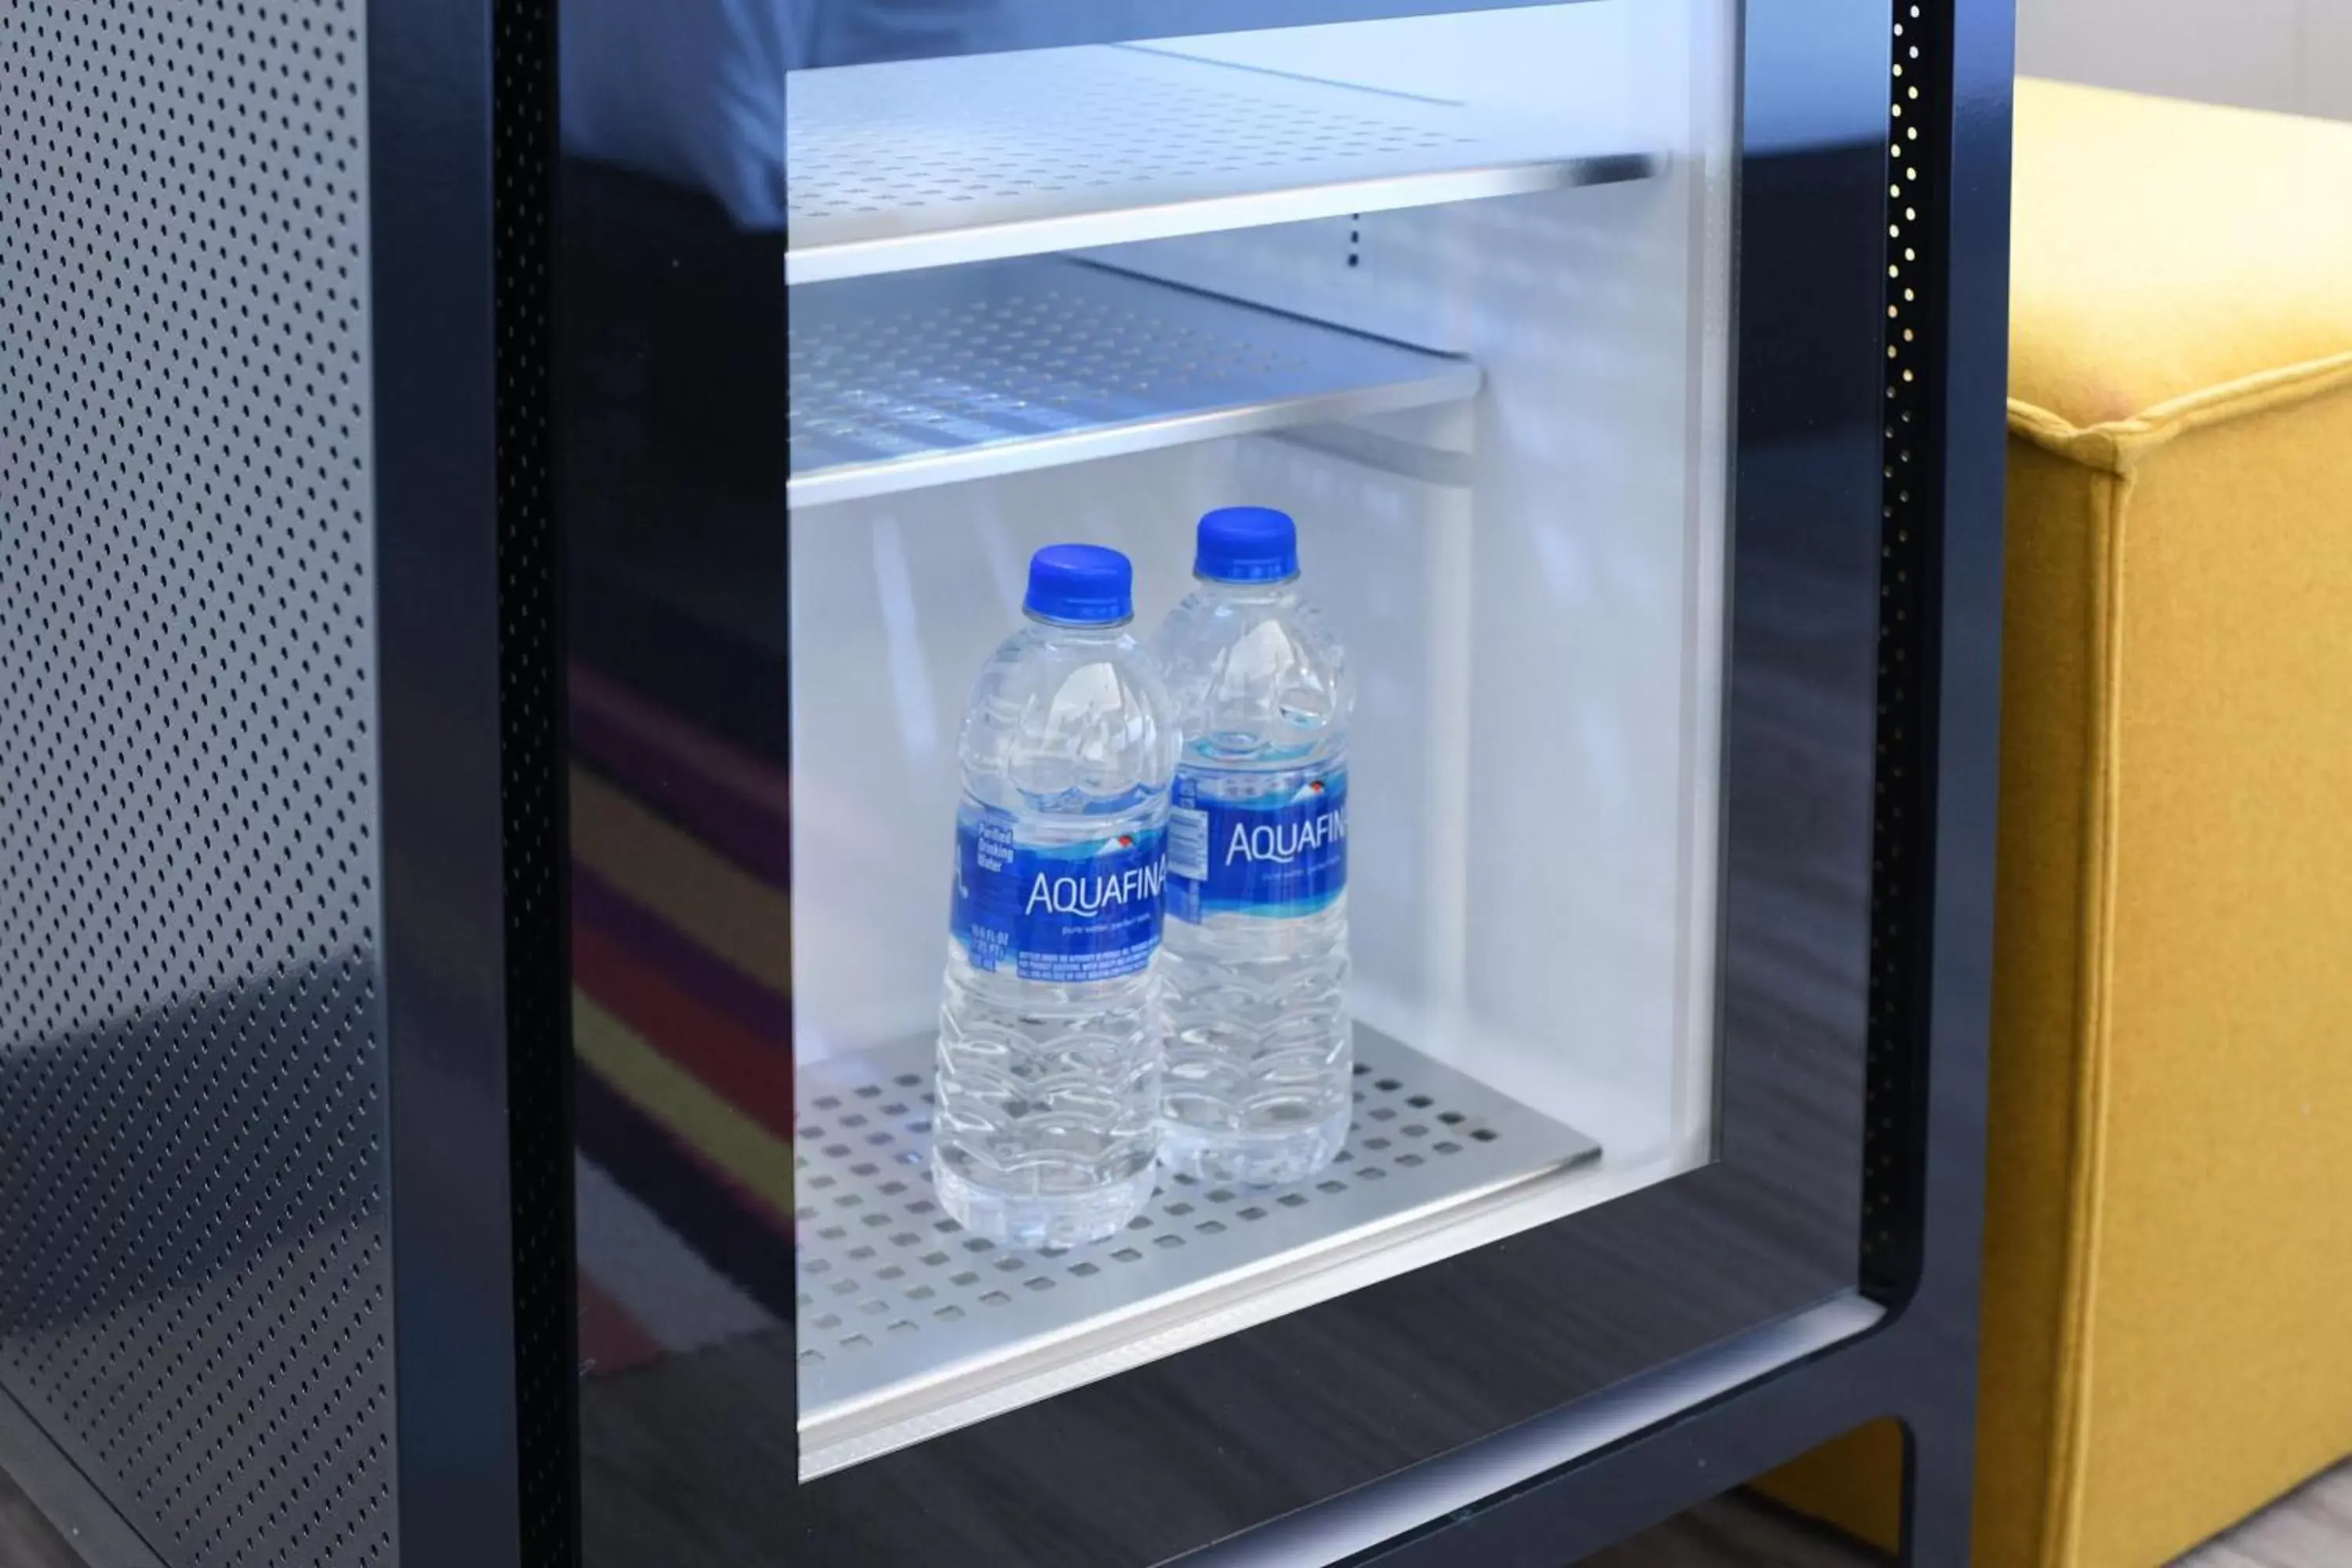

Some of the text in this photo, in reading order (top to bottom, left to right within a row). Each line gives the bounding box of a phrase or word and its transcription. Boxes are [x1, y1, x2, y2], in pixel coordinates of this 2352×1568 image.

[978, 821, 1013, 844] Purified
[1225, 808, 1348, 866] AQUAFIN
[977, 851, 1001, 873] Water
[978, 836, 1014, 863] Drinking
